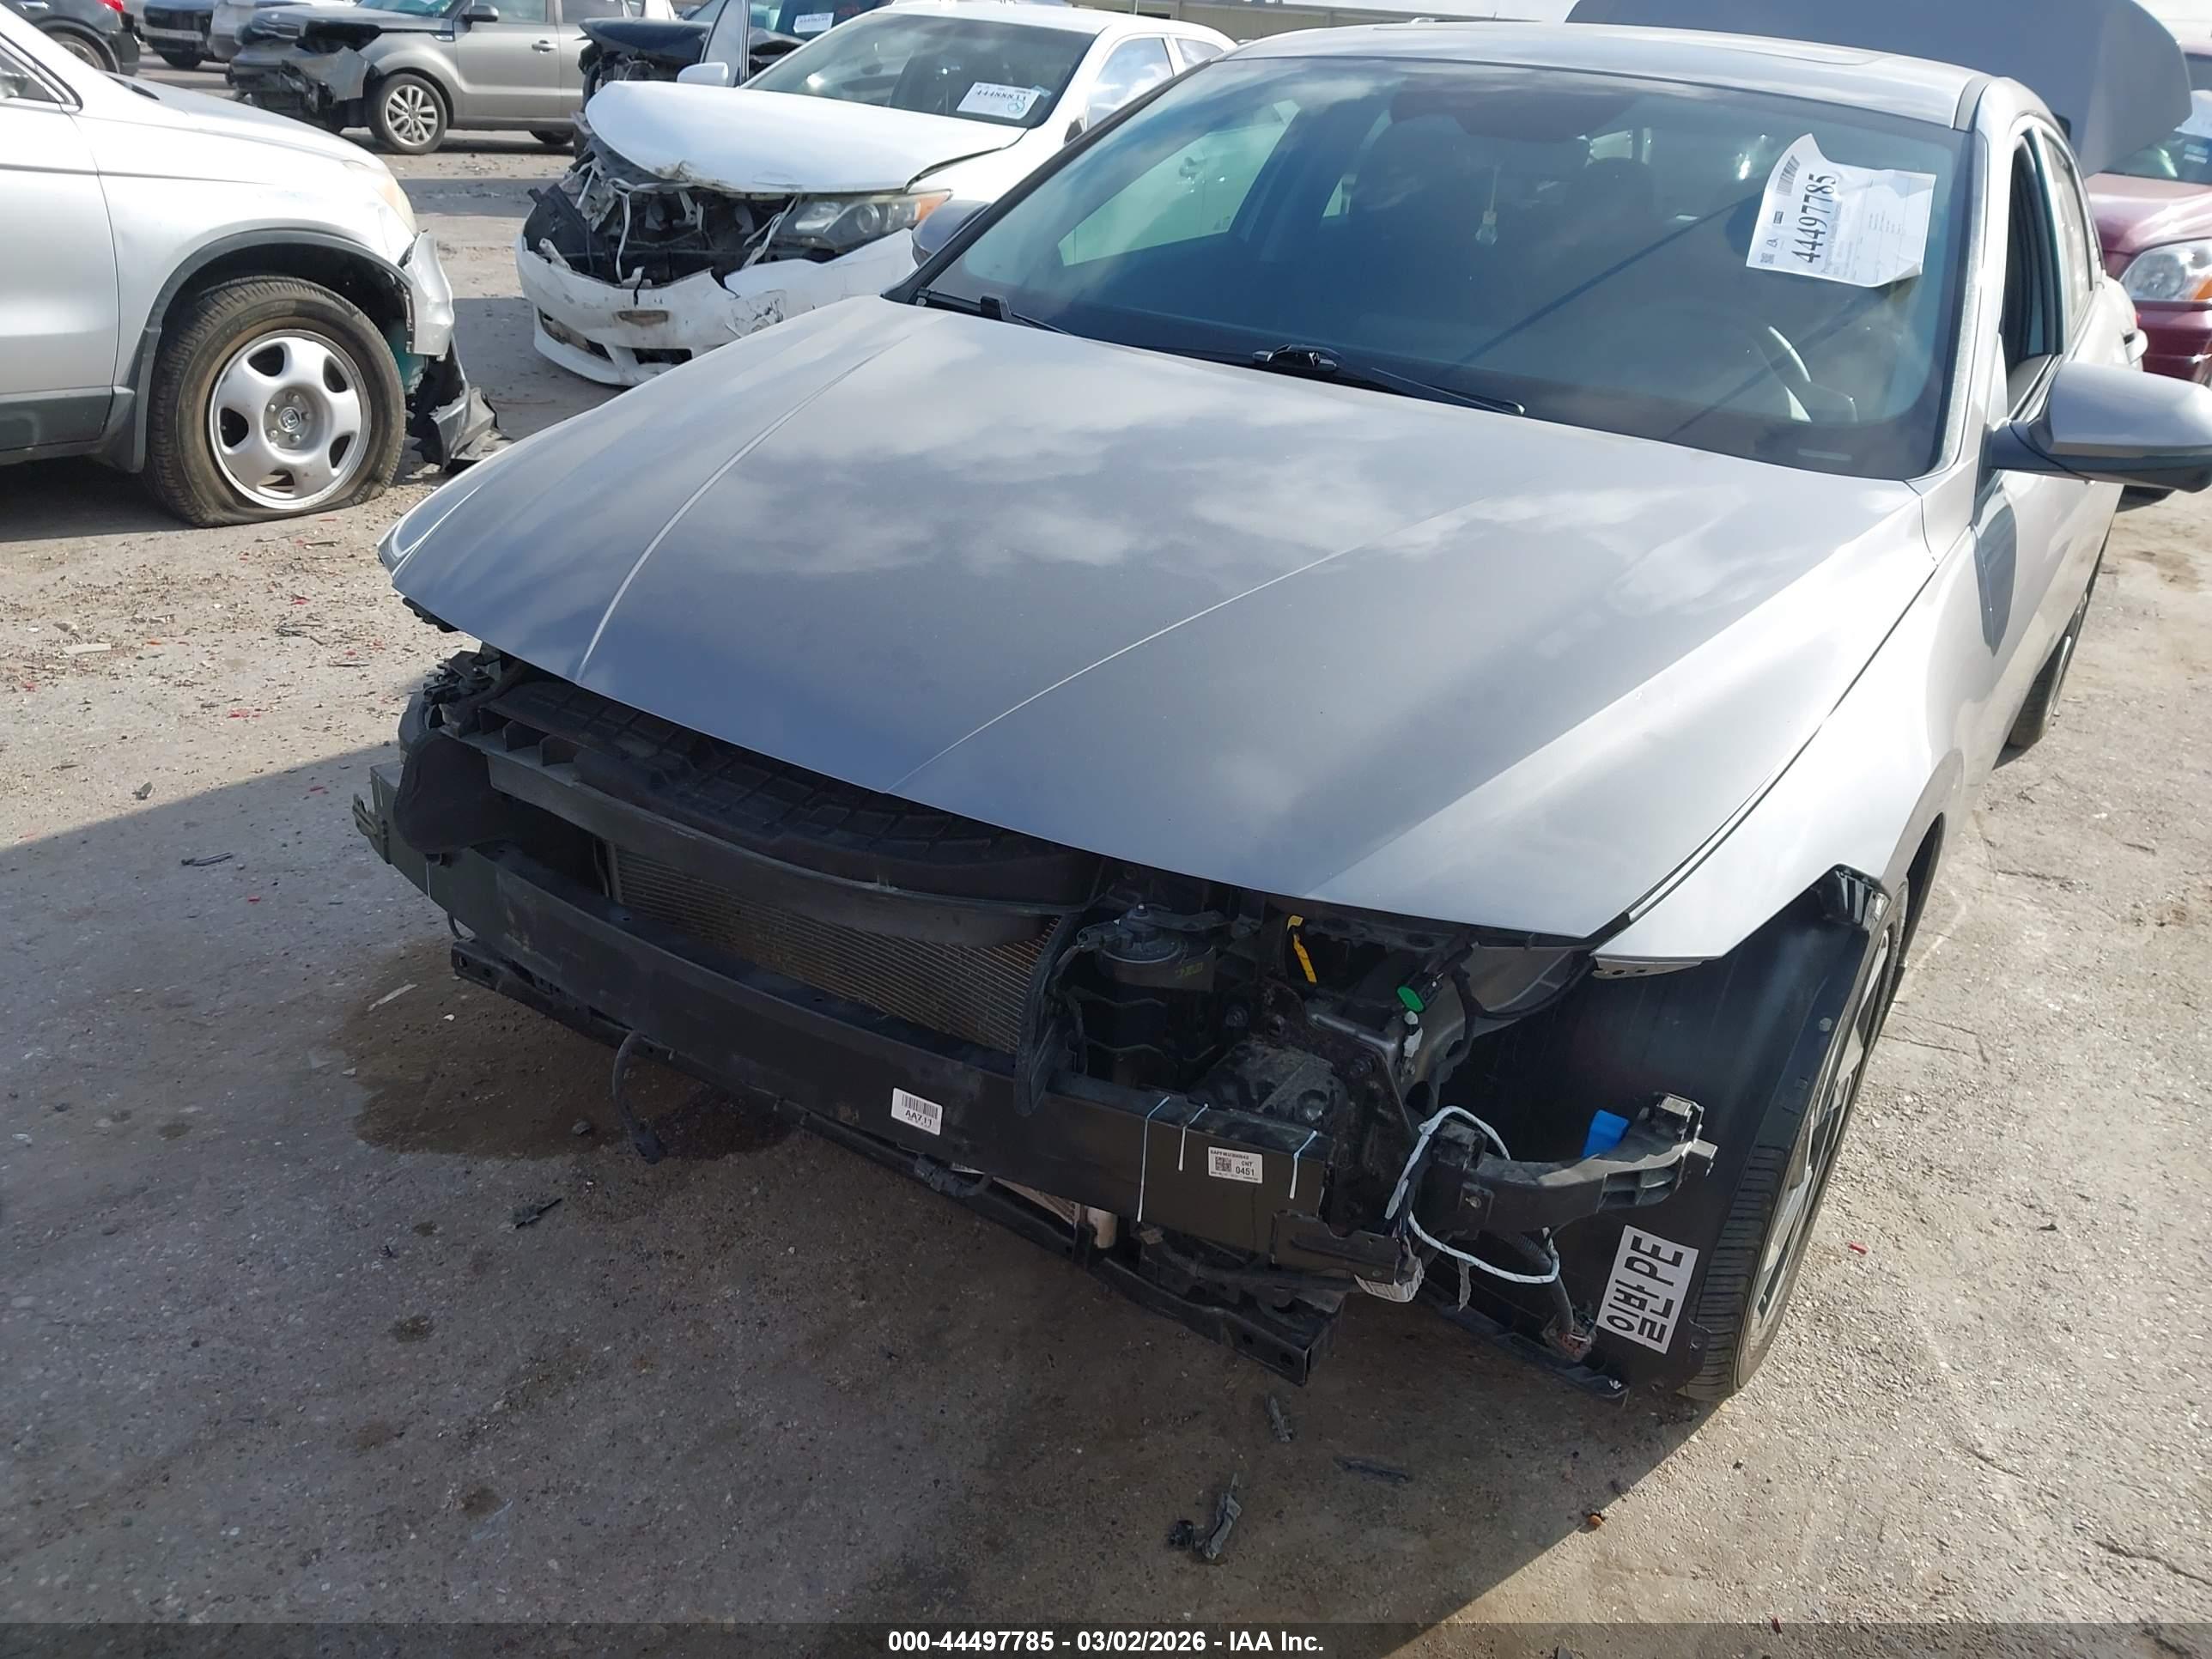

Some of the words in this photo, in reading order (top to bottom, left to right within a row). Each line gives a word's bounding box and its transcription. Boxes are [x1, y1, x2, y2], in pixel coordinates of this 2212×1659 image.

[1791, 173, 1837, 264] 44497785
[1236, 1166, 1255, 1176] 0451
[1625, 1235, 1684, 1286] PE
[1607, 1279, 1674, 1344] 일반
